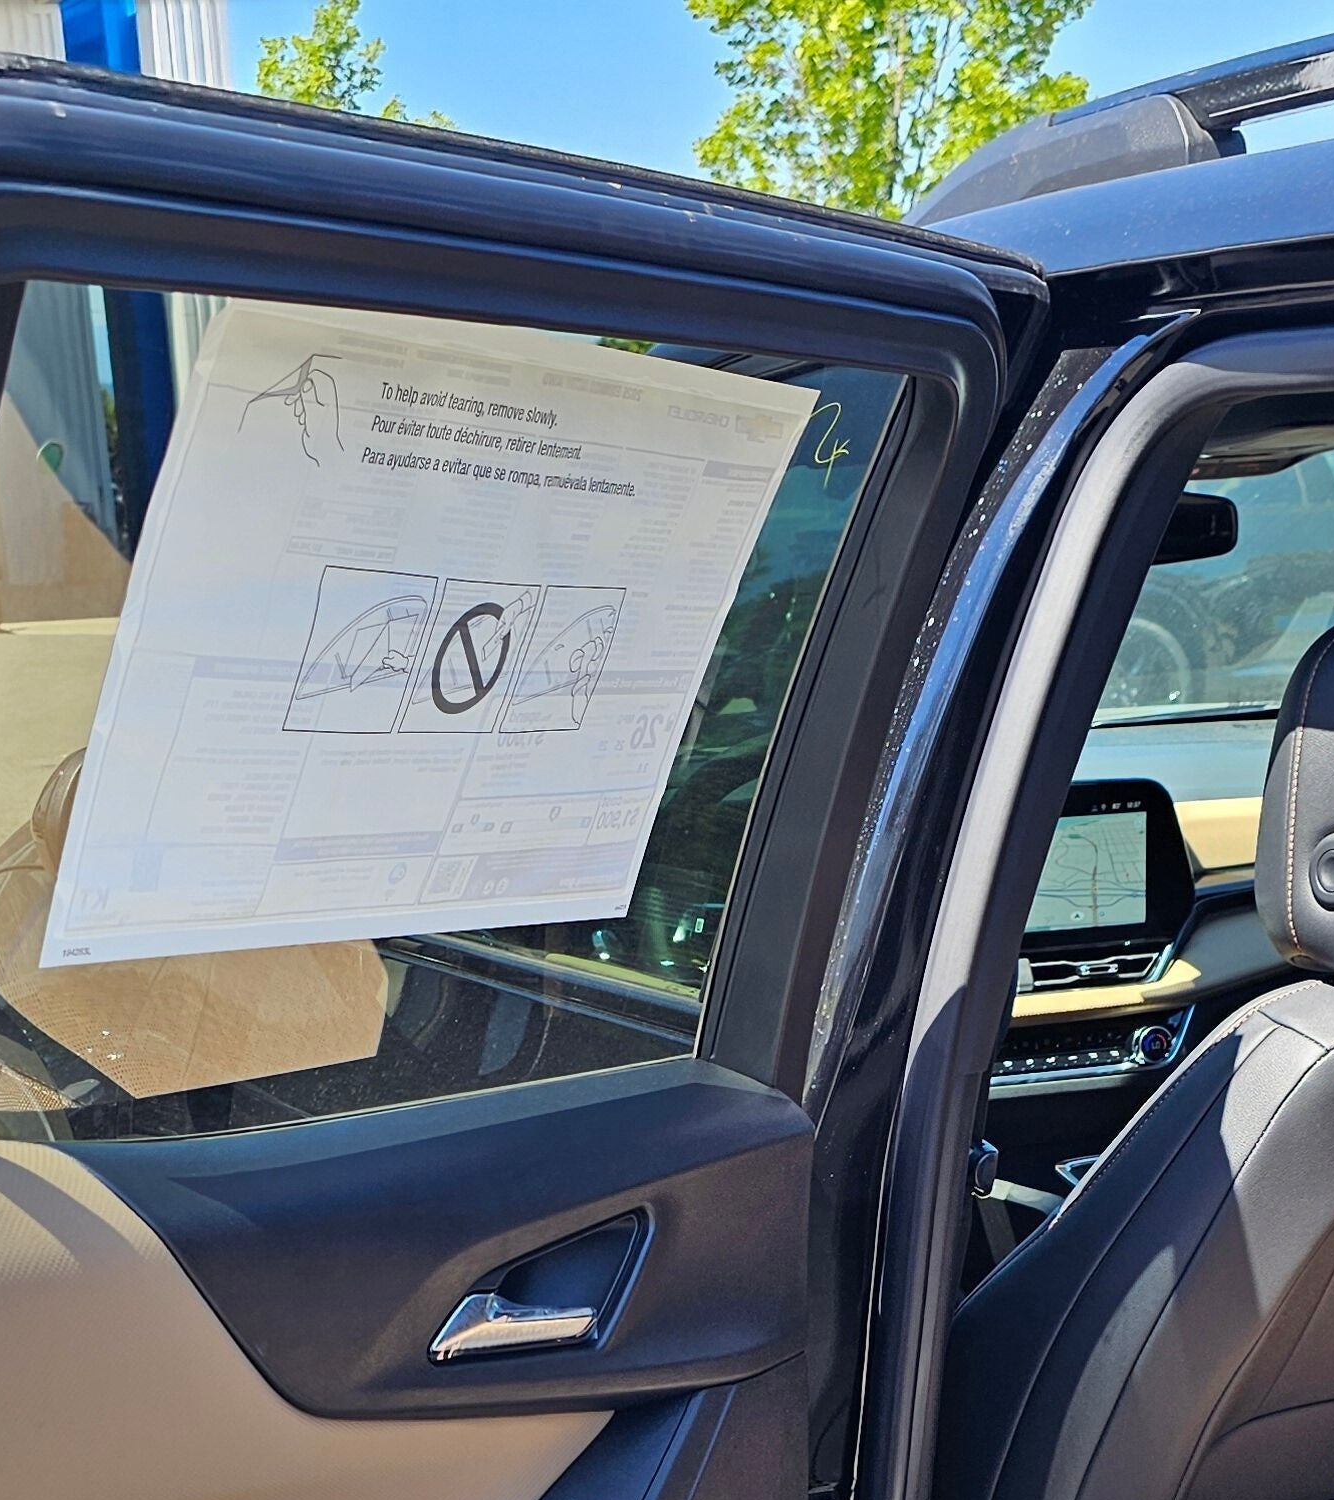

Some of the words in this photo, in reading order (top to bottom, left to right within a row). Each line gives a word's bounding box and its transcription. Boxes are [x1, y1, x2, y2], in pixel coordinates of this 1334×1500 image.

[382, 382, 394, 400] To
[395, 385, 418, 407] help
[420, 389, 447, 408] avoid
[448, 396, 485, 418] tearing,
[487, 402, 524, 422] remove
[525, 407, 558, 428] slowly.
[371, 415, 396, 433] Pour
[397, 418, 425, 437] éviter
[426, 423, 452, 441] toute
[453, 426, 503, 450] déchirure,
[505, 435, 537, 454] retirer
[361, 447, 385, 465] Para
[386, 452, 431, 471] ayudarse
[432, 460, 440, 472] a
[441, 456, 472, 476] evitar
[472, 462, 492, 481] que
[493, 466, 506, 480] se
[507, 469, 542, 488] rompa,
[588, 476, 636, 498] lentamente.
